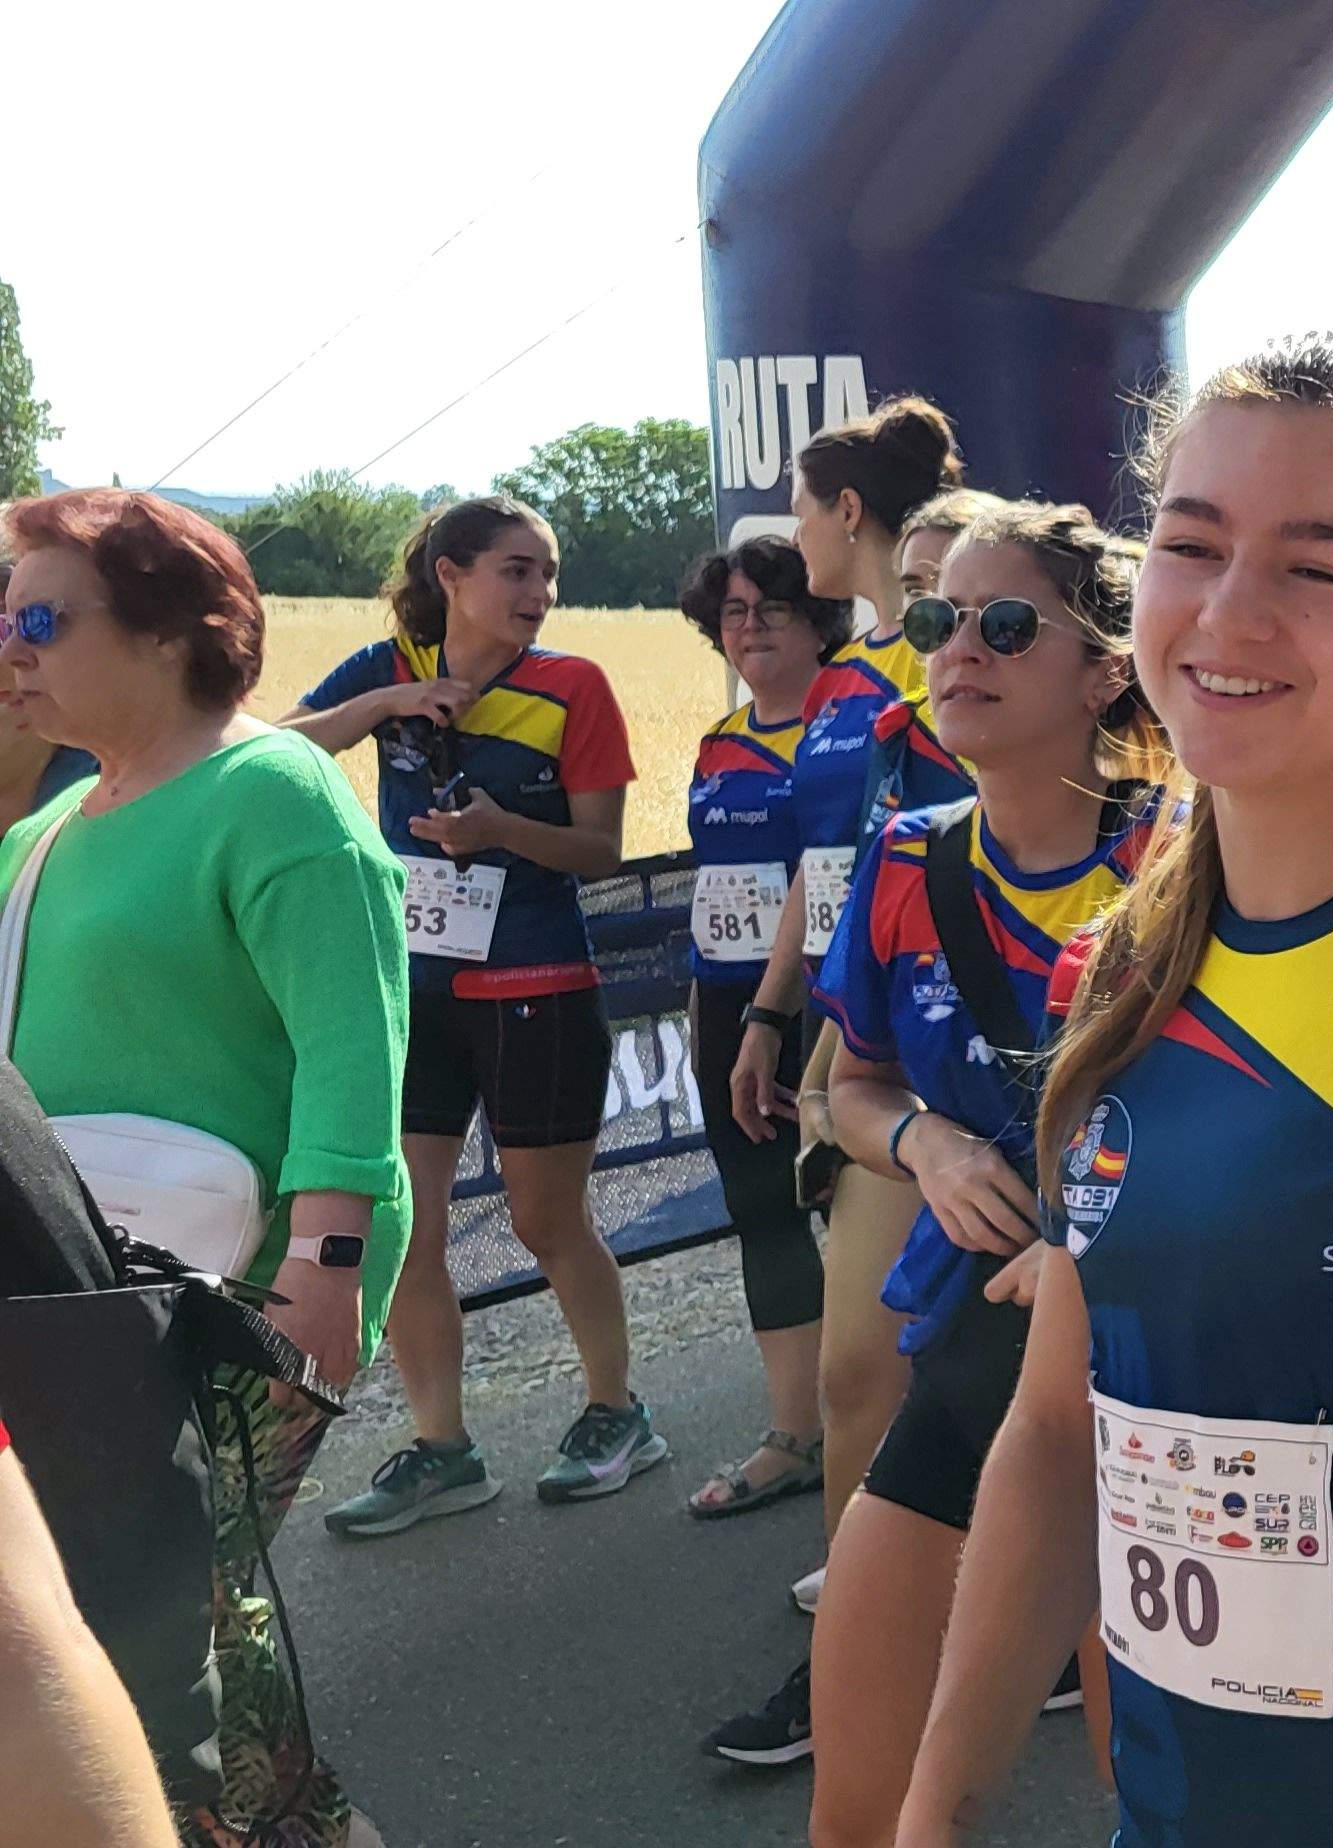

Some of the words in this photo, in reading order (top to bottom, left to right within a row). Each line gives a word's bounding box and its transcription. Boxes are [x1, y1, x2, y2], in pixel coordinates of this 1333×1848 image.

[717, 355, 868, 491] RUTA
[730, 808, 768, 826] mupol
[709, 912, 762, 941] 581
[809, 901, 845, 933] 58
[1082, 1186, 1115, 1207] 091
[1255, 1493, 1291, 1503] CEP
[1260, 1536, 1288, 1549] SPP
[1127, 1543, 1220, 1647] 80
[1211, 1677, 1298, 1700] POLICIA
[1261, 1697, 1323, 1708] NACIONAL
